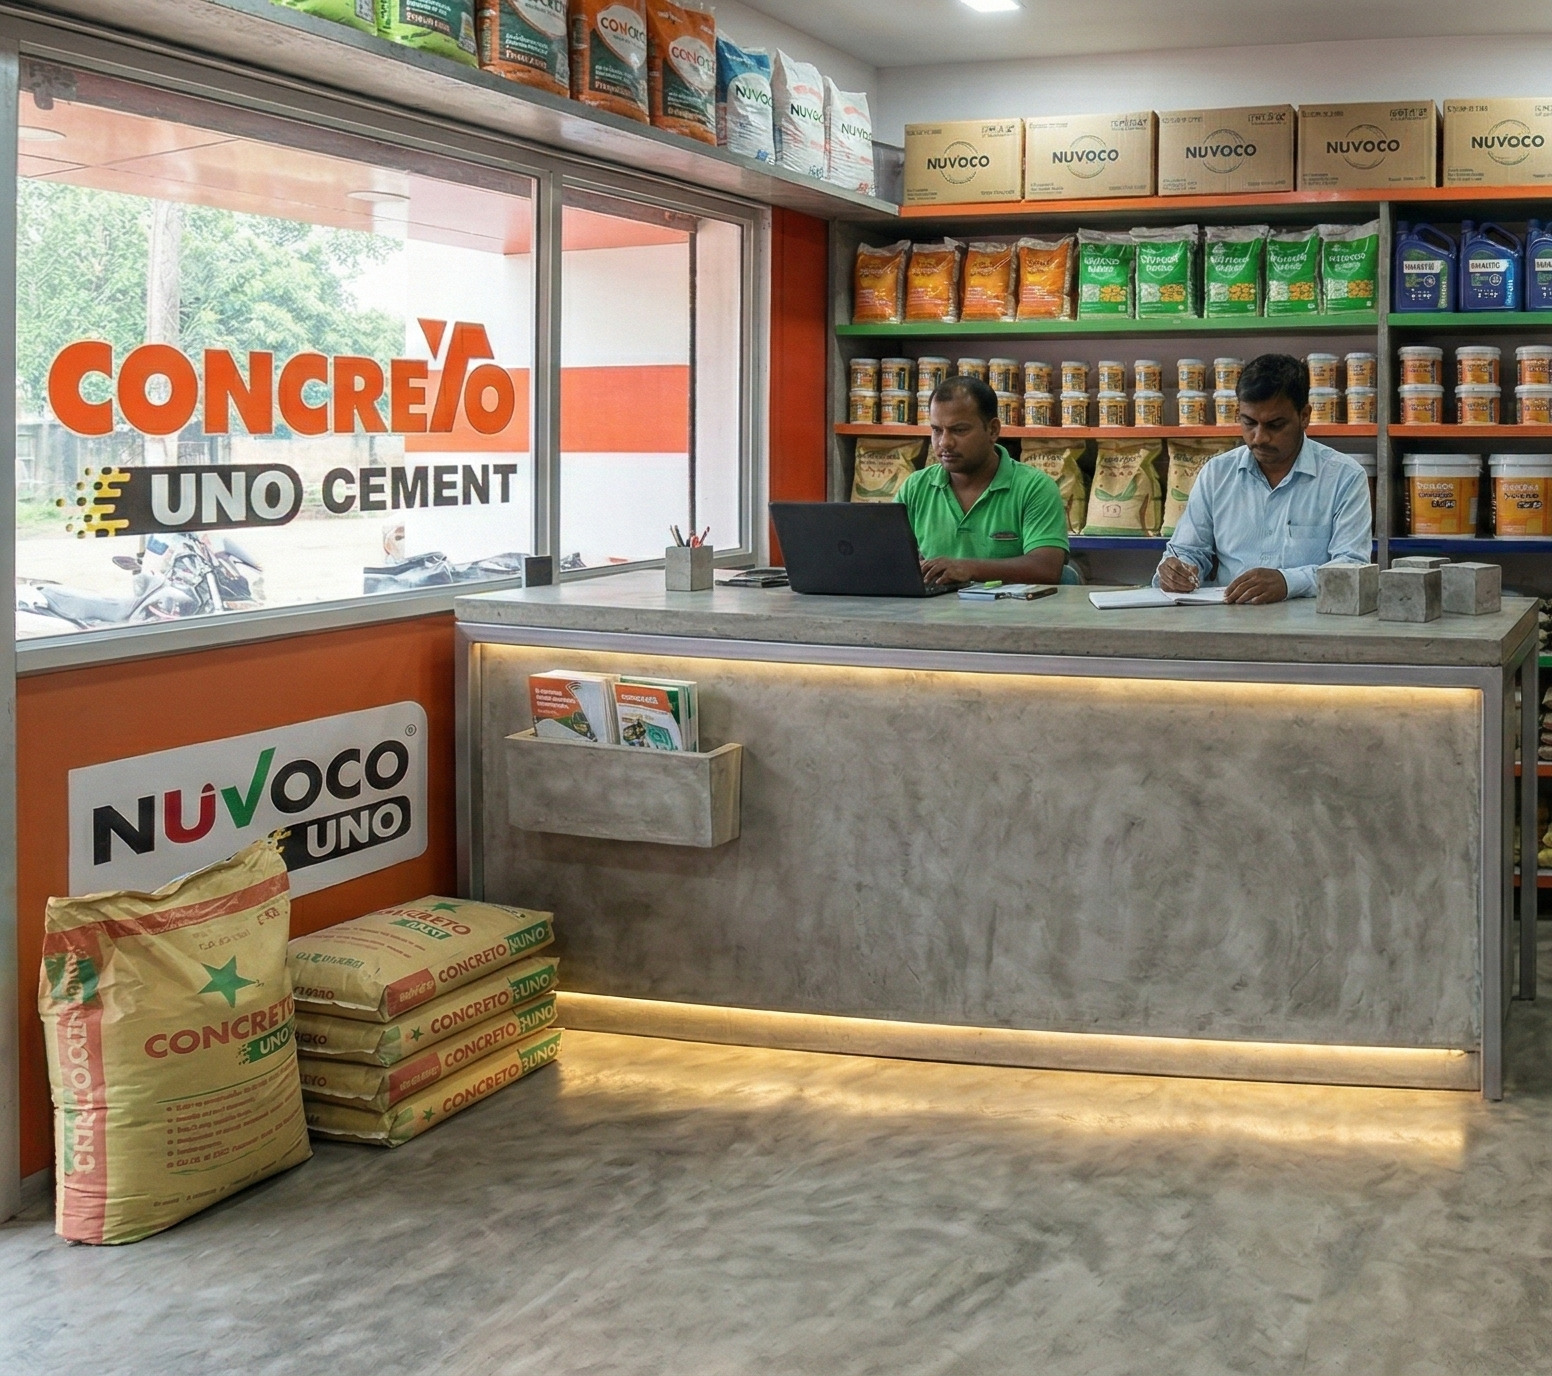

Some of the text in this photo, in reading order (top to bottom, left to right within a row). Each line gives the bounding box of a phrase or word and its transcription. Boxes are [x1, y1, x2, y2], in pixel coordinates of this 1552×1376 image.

[927, 154, 990, 170] NUVOCO
[1052, 148, 1119, 164] NUVOCO
[1186, 143, 1257, 159] NUVOCO
[1326, 139, 1400, 154] NUVOCO
[1471, 134, 1545, 149] NUVOCO
[48, 317, 515, 436] CONCRETO
[151, 464, 518, 527] UNO CEMENT
[93, 739, 409, 866] NUVOCO
[307, 802, 404, 858] UNO
[438, 943, 507, 983] CONCRETO
[430, 990, 509, 1034] CONCRETO
[259, 1026, 289, 1056] UNO
[444, 1022, 517, 1068] CONCRETO
[442, 1063, 519, 1112] CONCRETO
